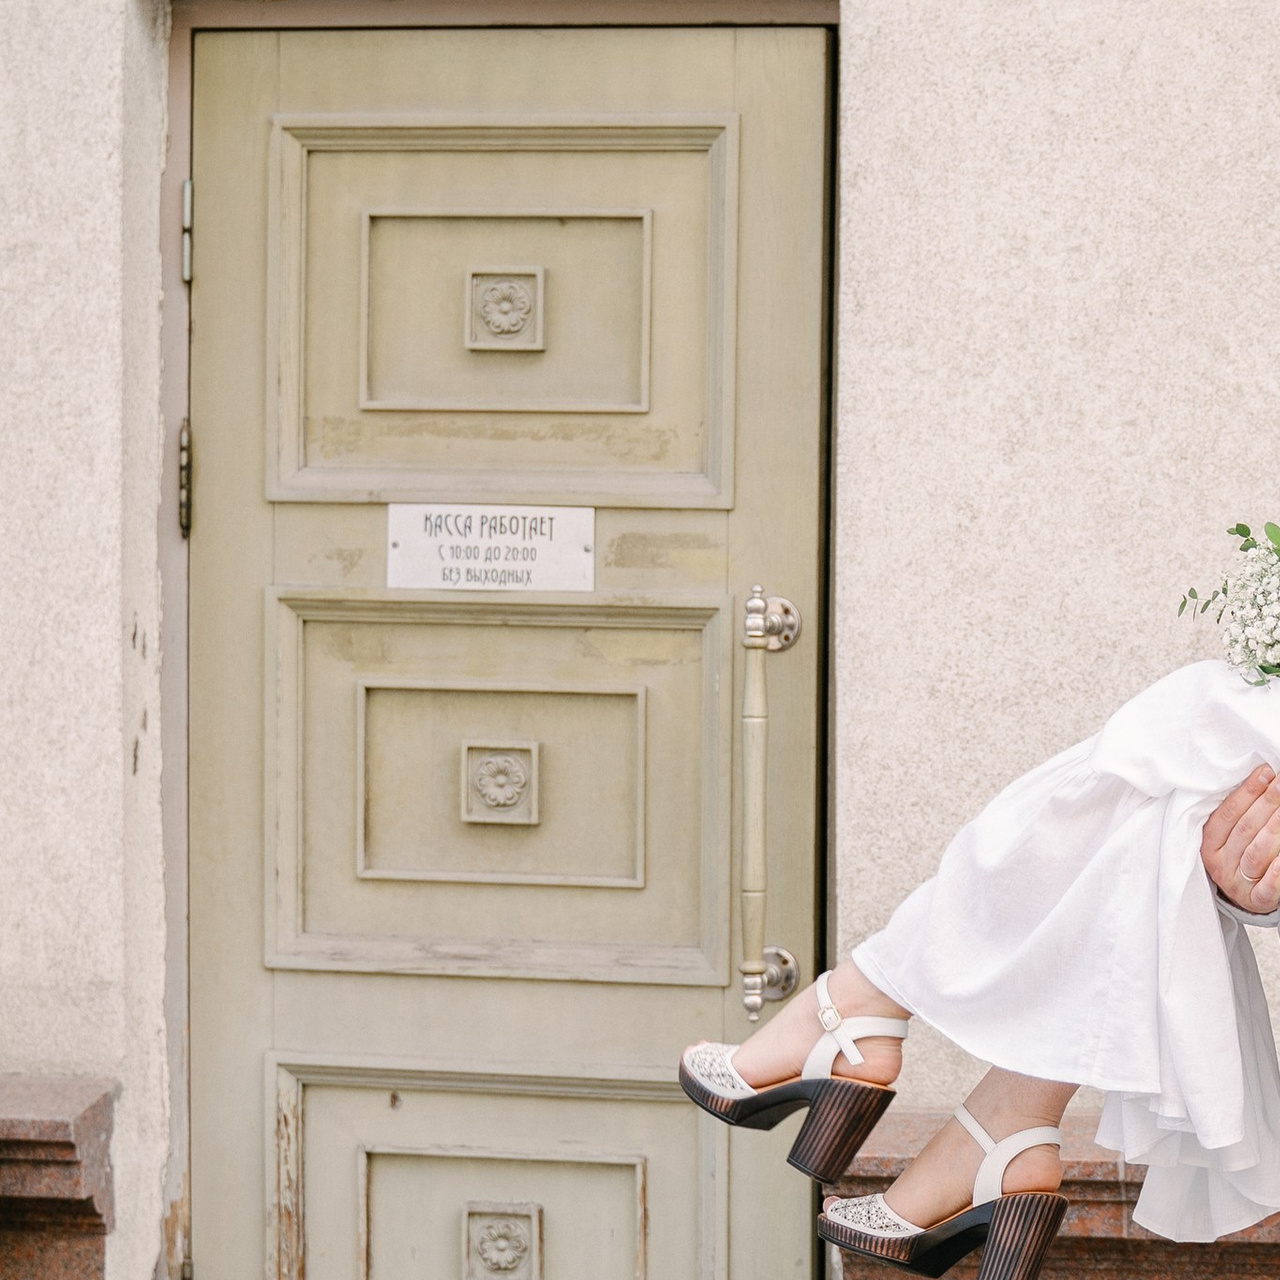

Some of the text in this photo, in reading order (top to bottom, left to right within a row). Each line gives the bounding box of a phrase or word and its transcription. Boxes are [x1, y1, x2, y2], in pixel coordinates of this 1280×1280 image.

[424, 513, 555, 541] КАССА РАБОТАЕТ
[450, 545, 480, 560] 10:00
[484, 546, 501, 563] ДО
[504, 546, 537, 562] 20:00
[442, 567, 533, 587] БЕЗ ВЫХОДНЫХ
